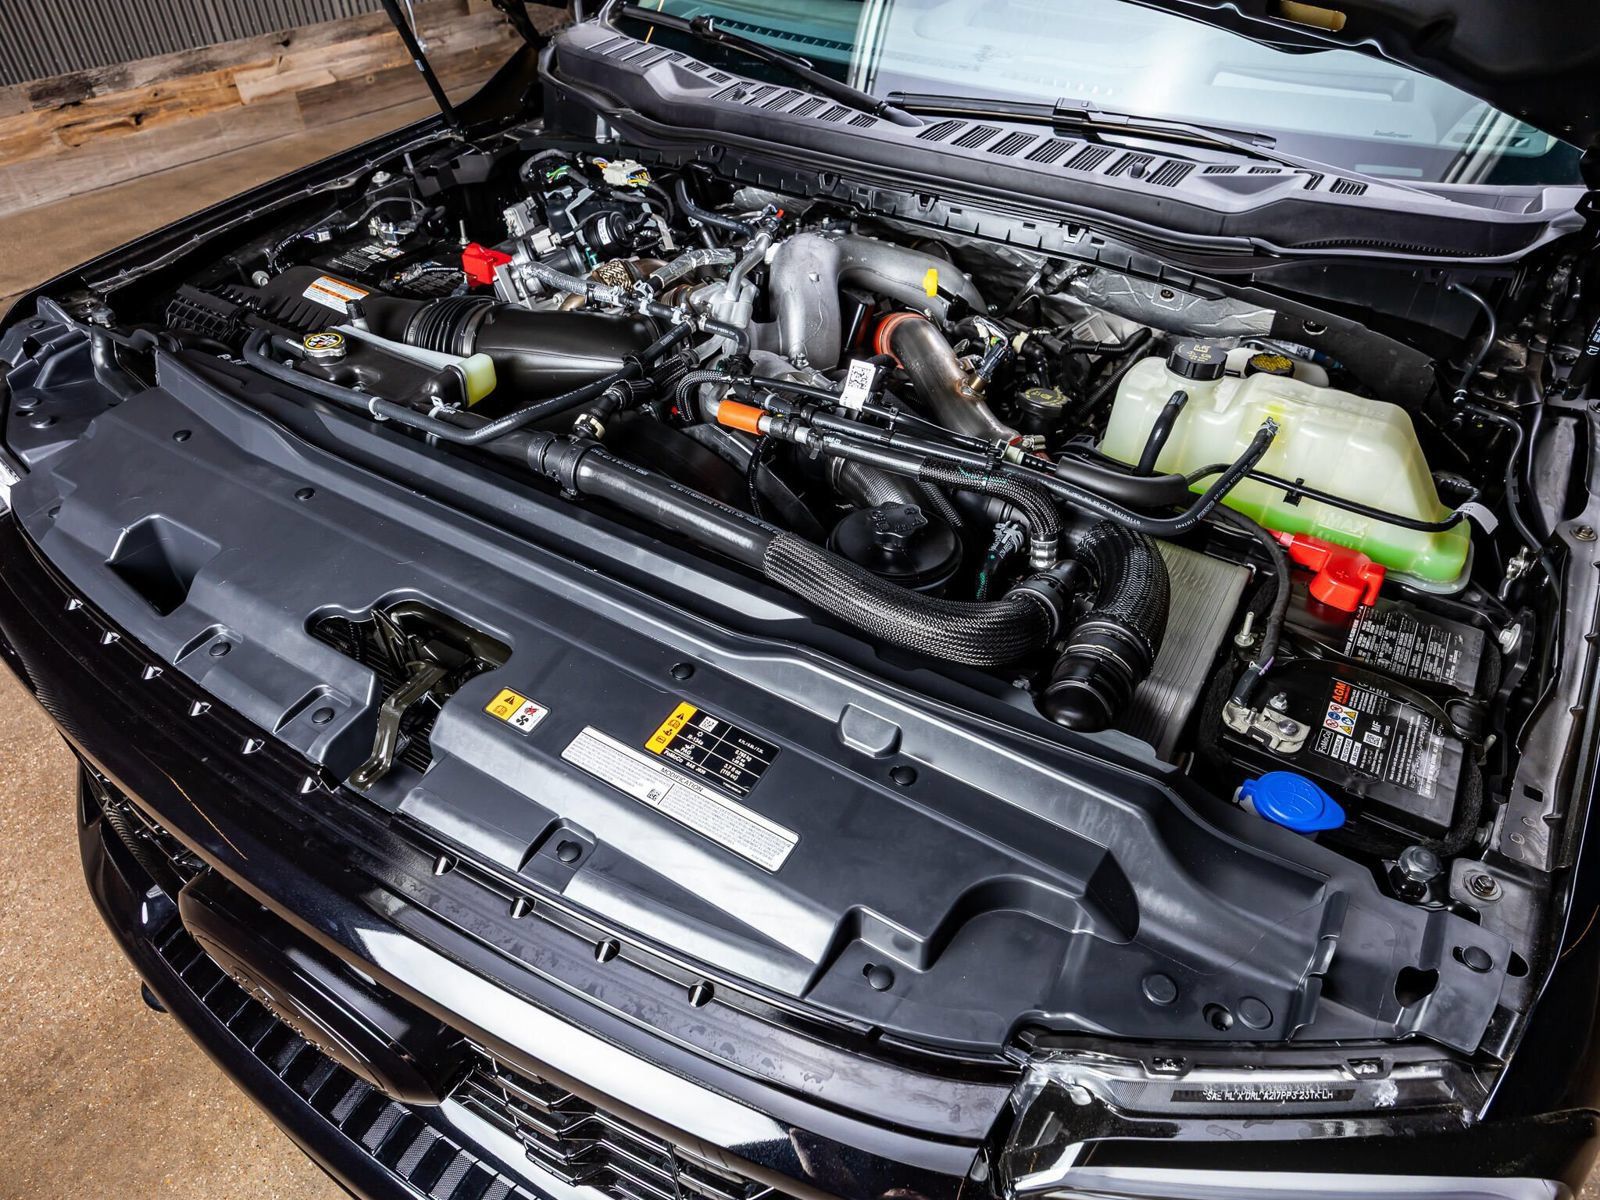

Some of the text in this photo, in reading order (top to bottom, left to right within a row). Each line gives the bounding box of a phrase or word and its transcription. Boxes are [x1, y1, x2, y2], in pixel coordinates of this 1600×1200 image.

[1332, 681, 1346, 703] AGM
[1319, 731, 1332, 754] FoMoCo
[661, 767, 704, 792] MODIFICATION
[1206, 1091, 1222, 1101] SAE
[1245, 1091, 1261, 1100] DRL
[1322, 1089, 1333, 1099] LH
